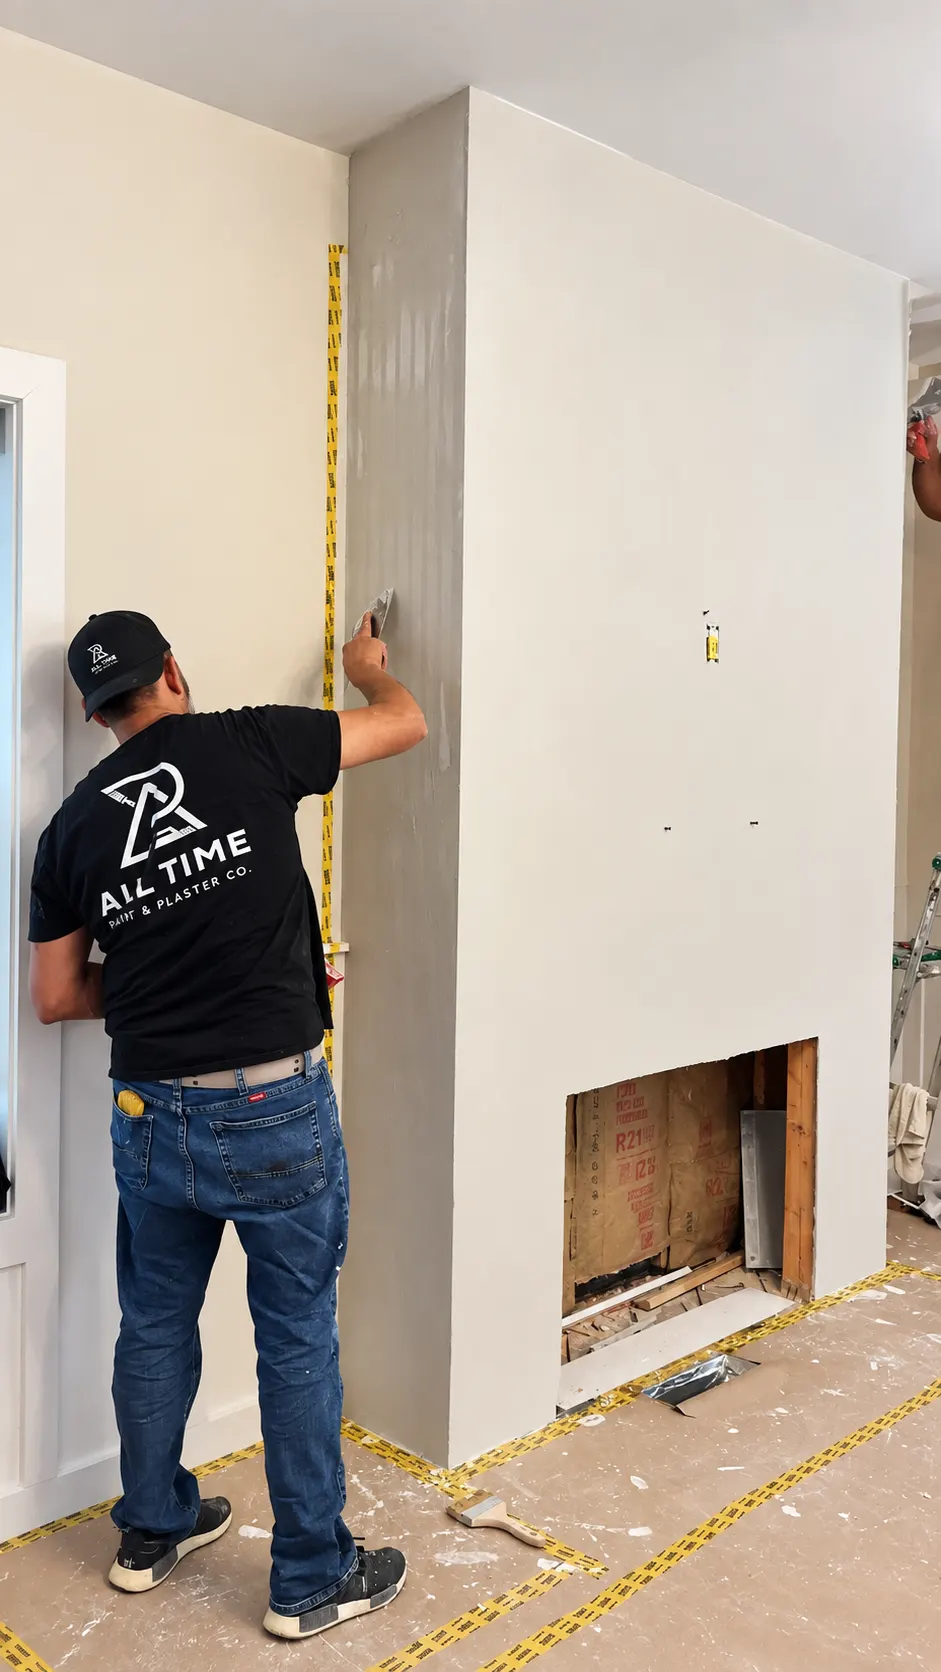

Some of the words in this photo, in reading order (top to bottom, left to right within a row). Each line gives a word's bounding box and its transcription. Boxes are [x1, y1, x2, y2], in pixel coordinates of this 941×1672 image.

[101, 877, 155, 917] ALL
[157, 828, 252, 884] TIME
[142, 905, 151, 916] &
[156, 876, 220, 910] PLASTER
[226, 866, 252, 881] CO.
[616, 1127, 642, 1154] R21
